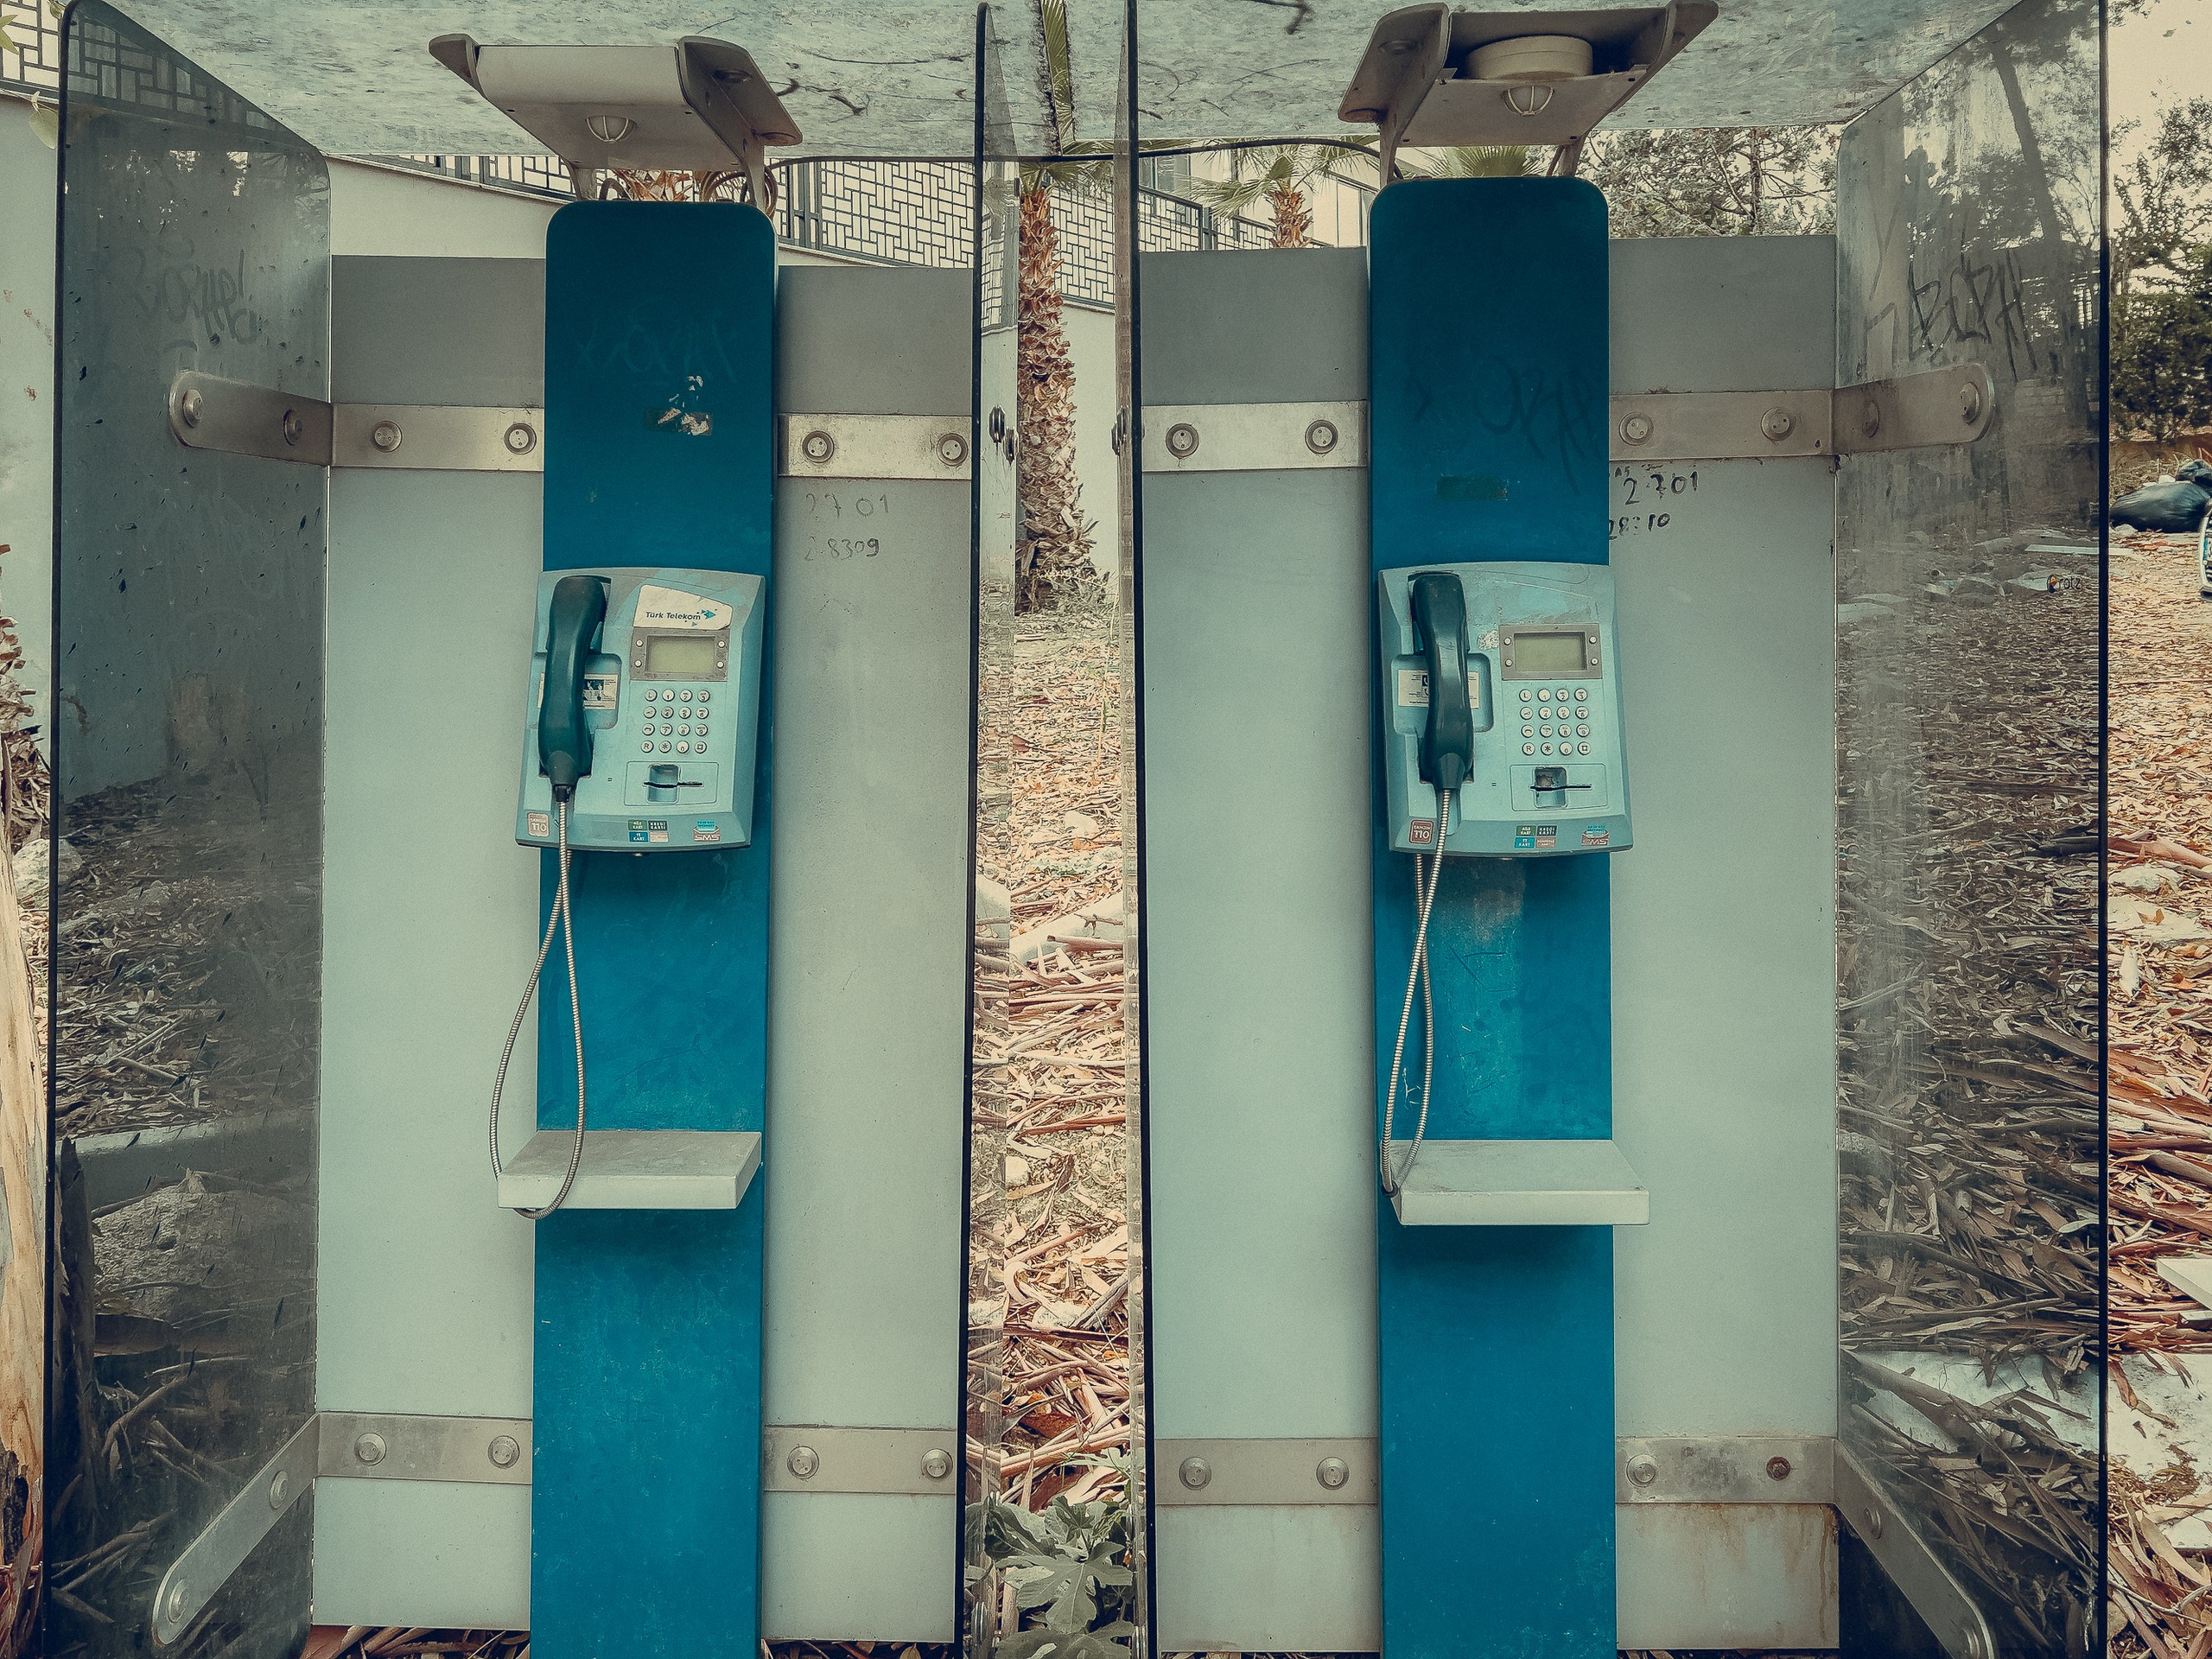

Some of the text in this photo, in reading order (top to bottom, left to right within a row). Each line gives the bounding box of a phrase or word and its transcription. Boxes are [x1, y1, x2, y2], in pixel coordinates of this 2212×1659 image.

[666, 612, 702, 620] Telekom
[531, 822, 547, 832] 110
[1413, 830, 1430, 839] 110
